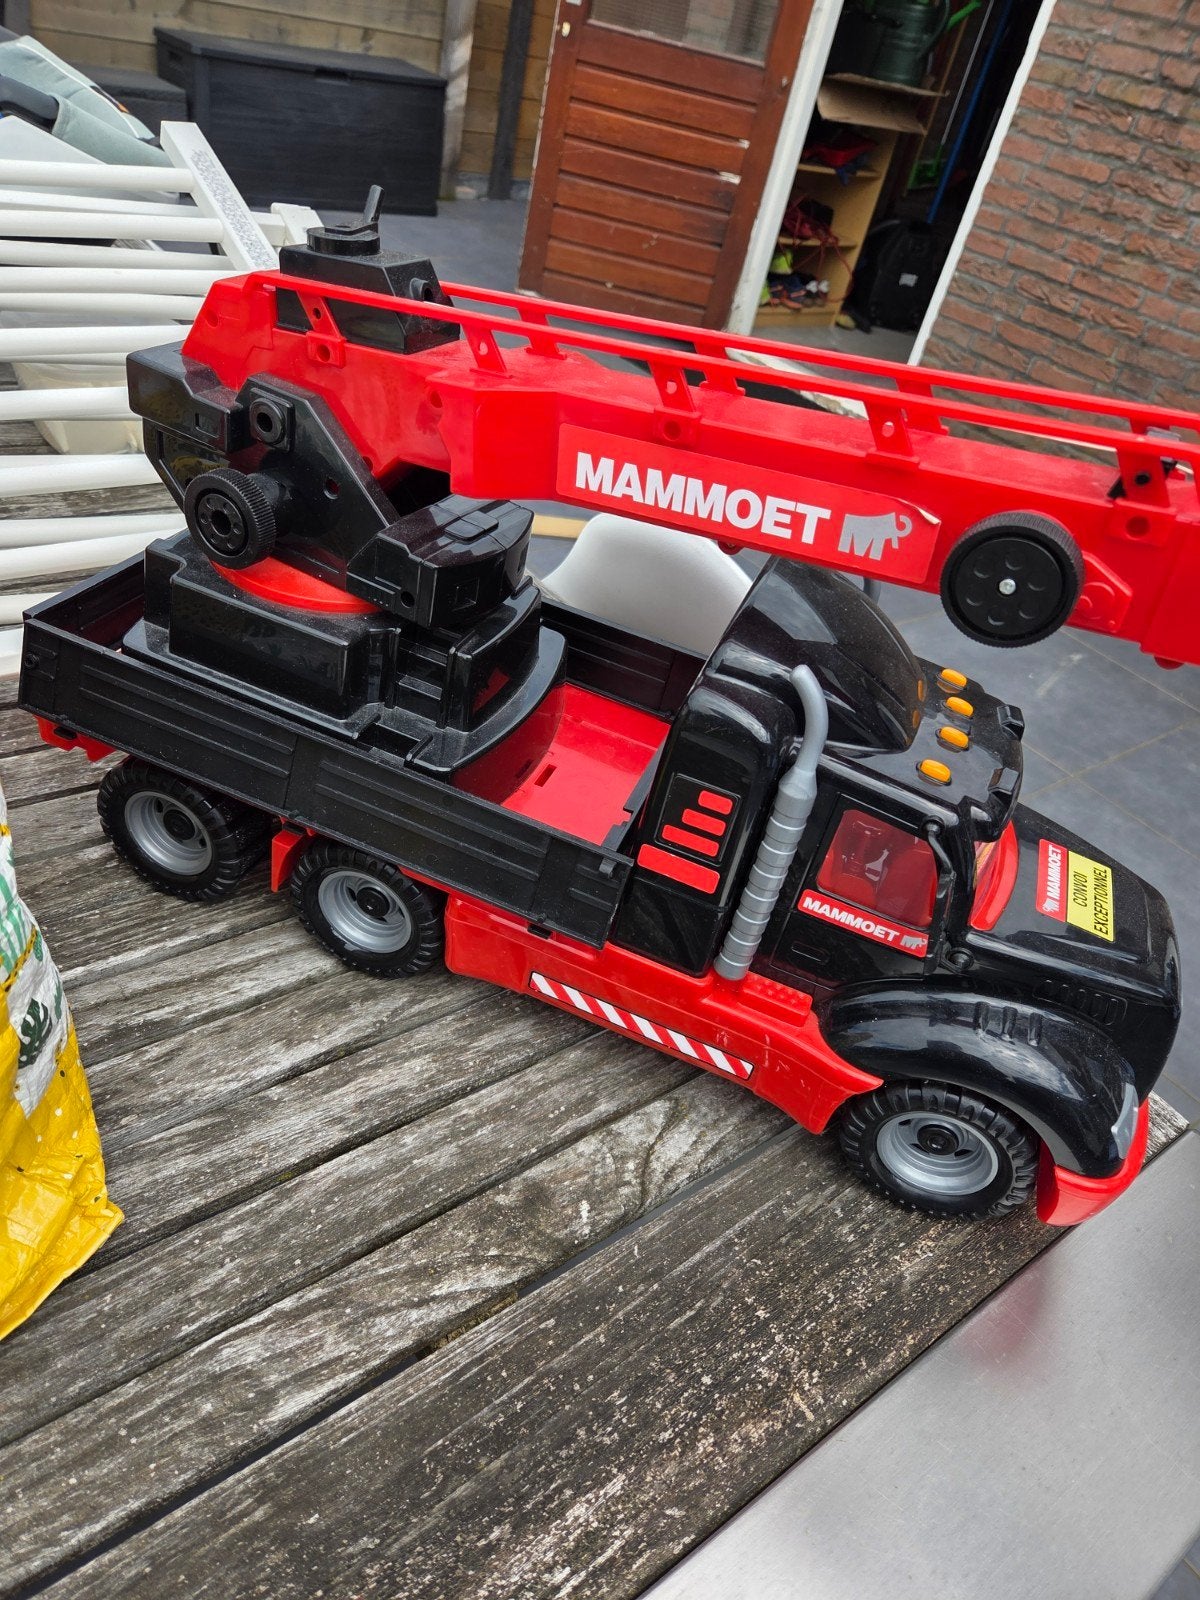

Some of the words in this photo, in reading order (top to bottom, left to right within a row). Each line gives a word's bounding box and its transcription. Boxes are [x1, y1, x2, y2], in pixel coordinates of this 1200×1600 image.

[575, 451, 831, 545] MAMMOET
[1047, 844, 1062, 900] MAMMOET
[1072, 871, 1088, 908] CONVOI
[802, 897, 900, 942] MAMMOET
[1093, 867, 1109, 936] EXCEPTIONNEL
